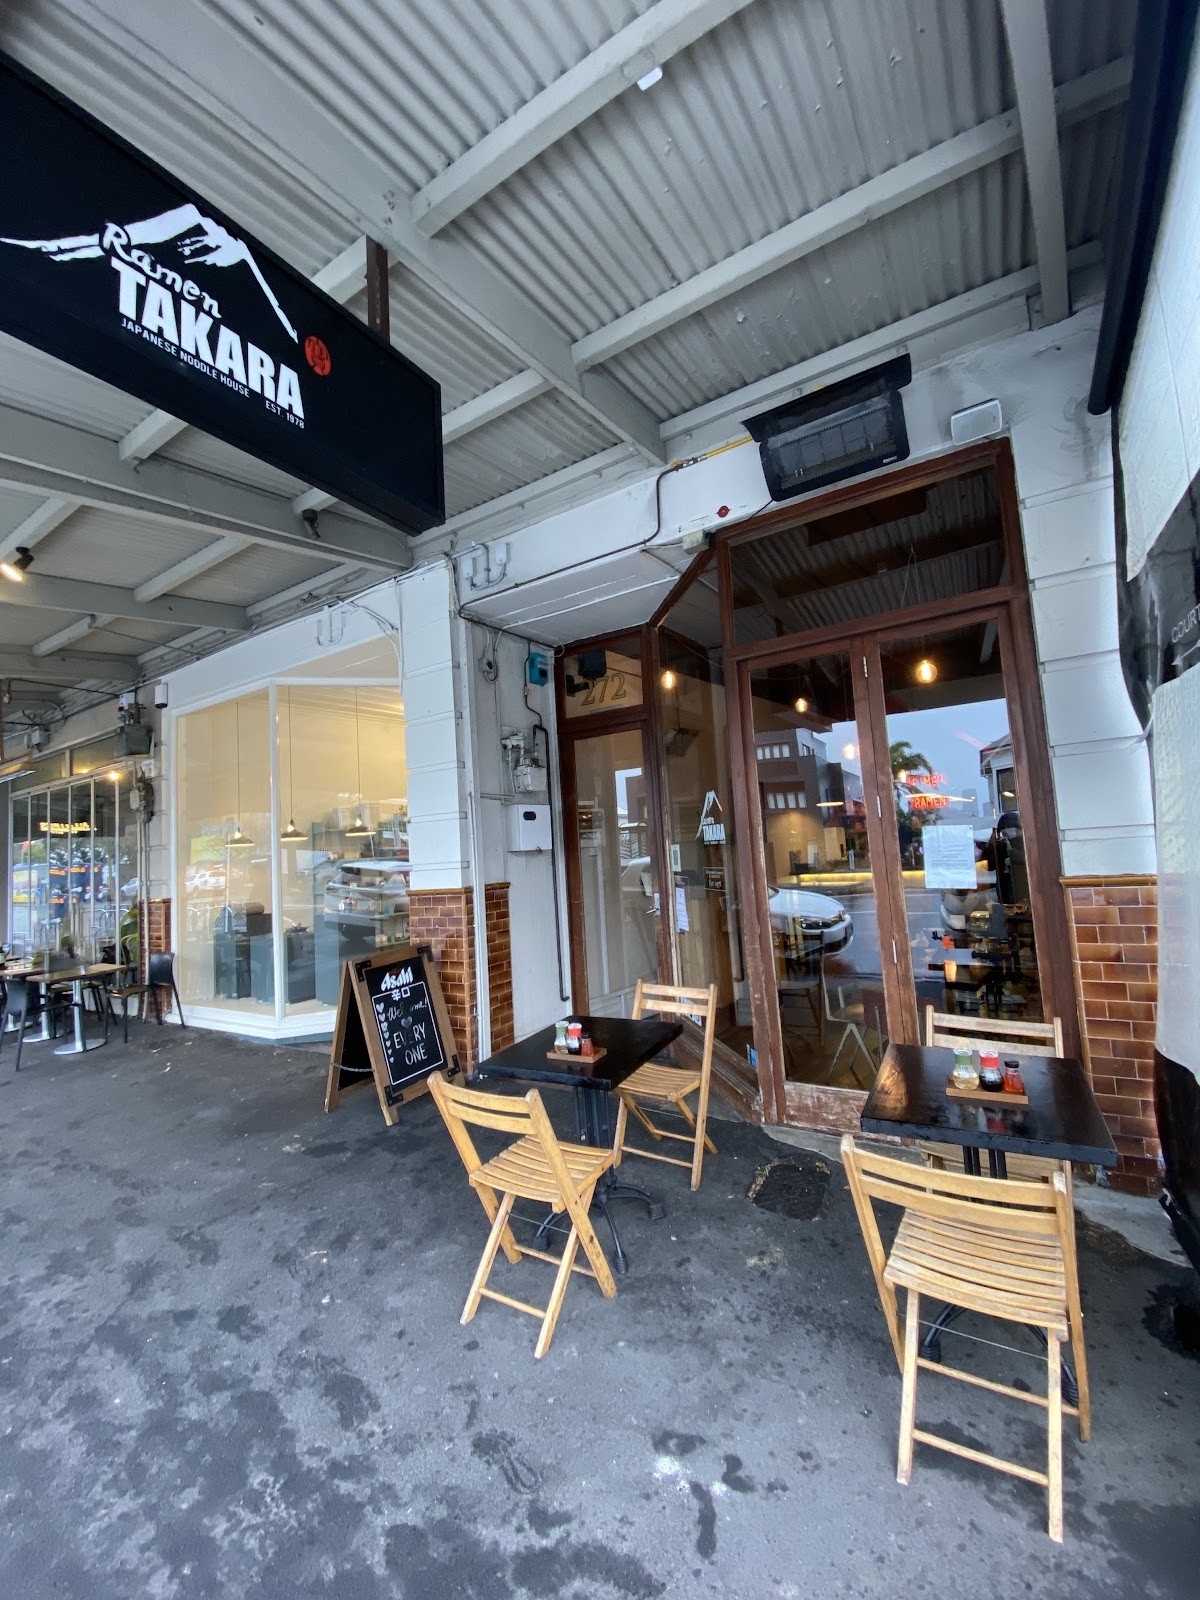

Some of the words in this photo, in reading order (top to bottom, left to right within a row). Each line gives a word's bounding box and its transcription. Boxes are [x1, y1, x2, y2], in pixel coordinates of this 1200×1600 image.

[102, 221, 222, 319] Ramen
[111, 256, 305, 420] TAKARA
[121, 318, 178, 357] JAPANESE
[180, 350, 218, 380] NOODLE
[220, 373, 250, 398] HOUSE
[286, 412, 305, 429] 1978
[580, 672, 627, 706] 272
[914, 796, 946, 809] RAMEN
[381, 966, 414, 992] Asahi
[393, 1021, 426, 1049] EVRY
[404, 1042, 428, 1066] ONE
